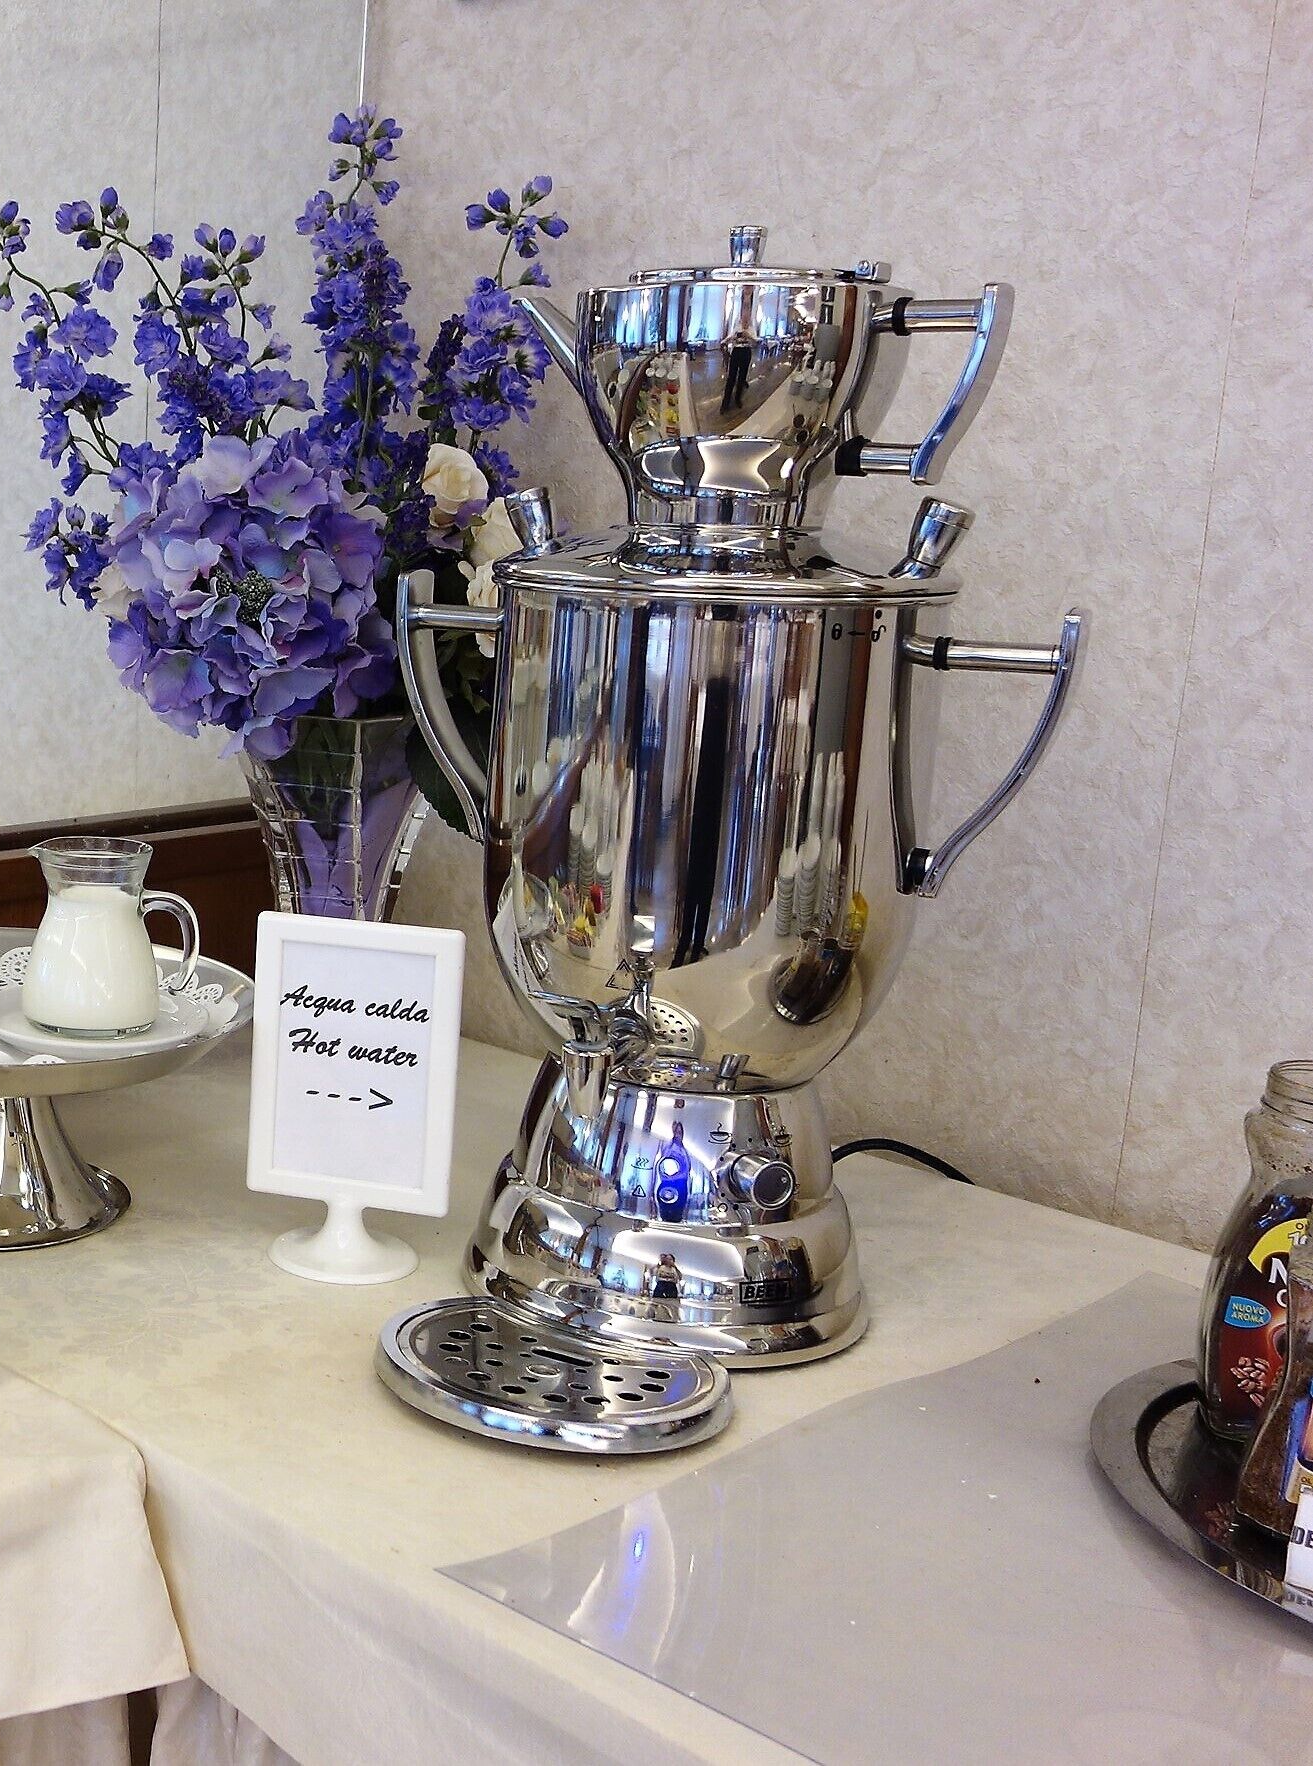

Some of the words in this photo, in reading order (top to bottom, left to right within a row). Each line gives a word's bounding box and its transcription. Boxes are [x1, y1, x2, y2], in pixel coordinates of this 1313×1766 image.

[280, 985, 356, 1018] Acqua
[365, 999, 430, 1023] calda
[289, 1028, 341, 1055] Hot
[348, 1040, 418, 1067] water
[1231, 1302, 1267, 1316] NUOVO
[1231, 1311, 1265, 1325] AROMA
